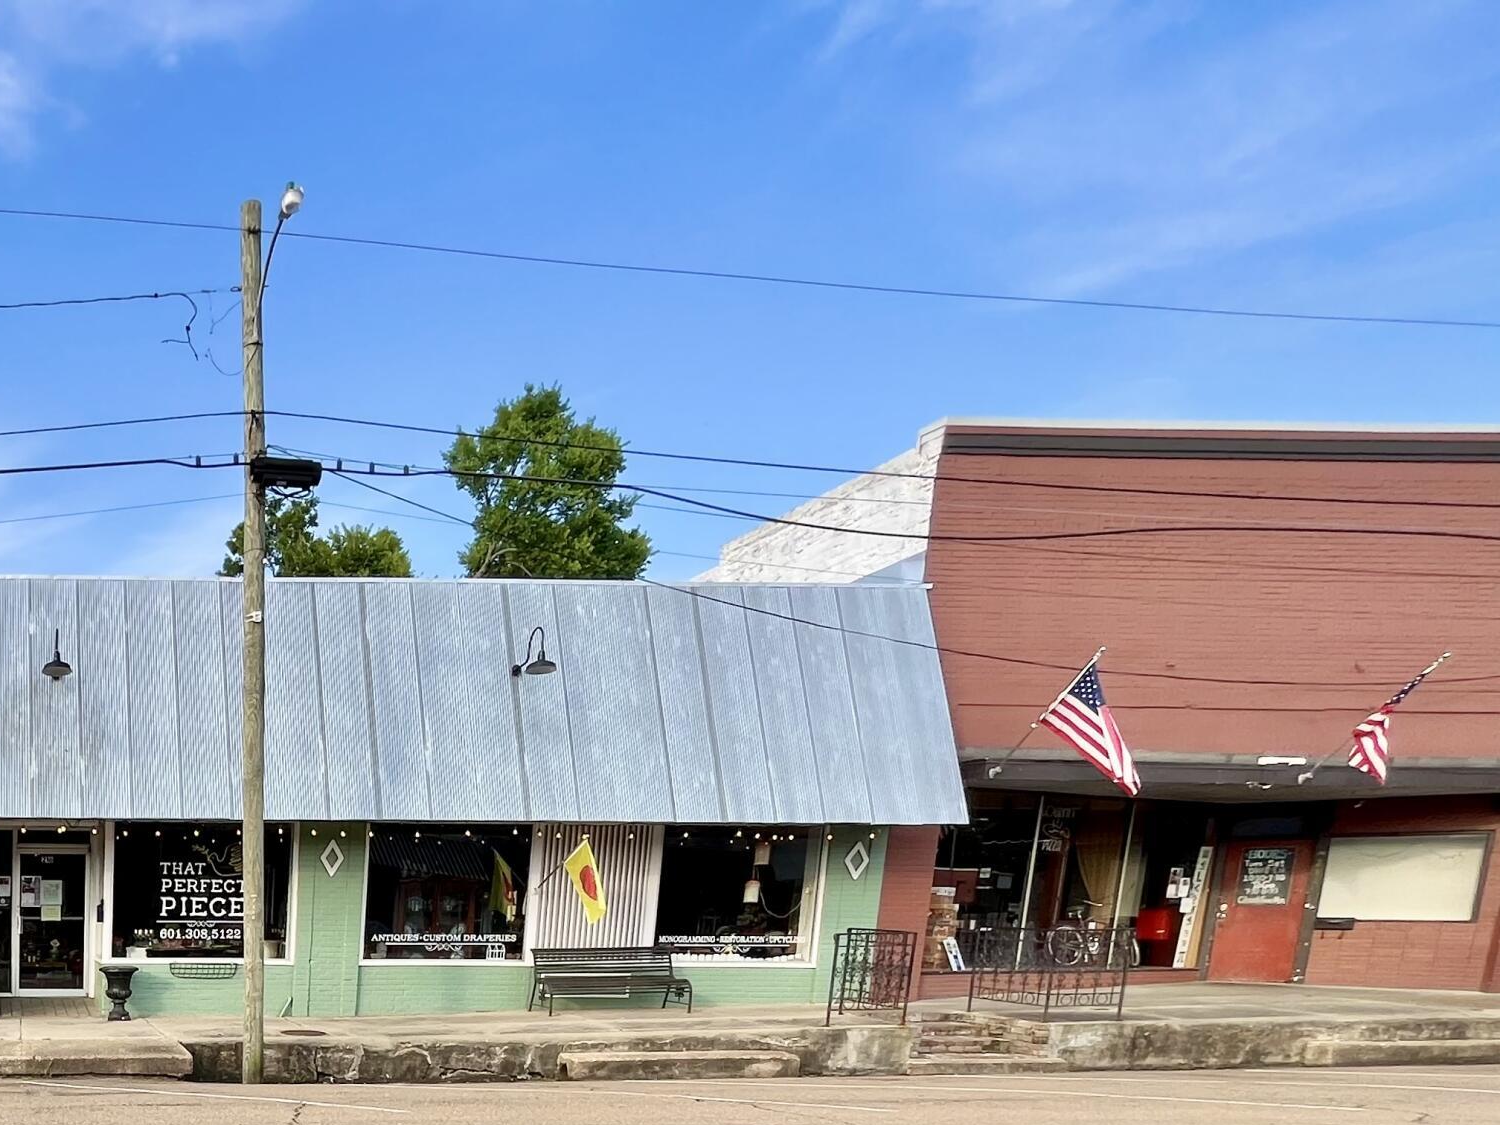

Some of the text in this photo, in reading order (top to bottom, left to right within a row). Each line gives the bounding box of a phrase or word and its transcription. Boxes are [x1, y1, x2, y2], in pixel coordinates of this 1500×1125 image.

[159, 861, 206, 875] THAT
[160, 878, 244, 893] PERFECT
[159, 896, 244, 917] PIECE
[371, 933, 517, 942] ANTIQUES CUSTOM DRAPERIES
